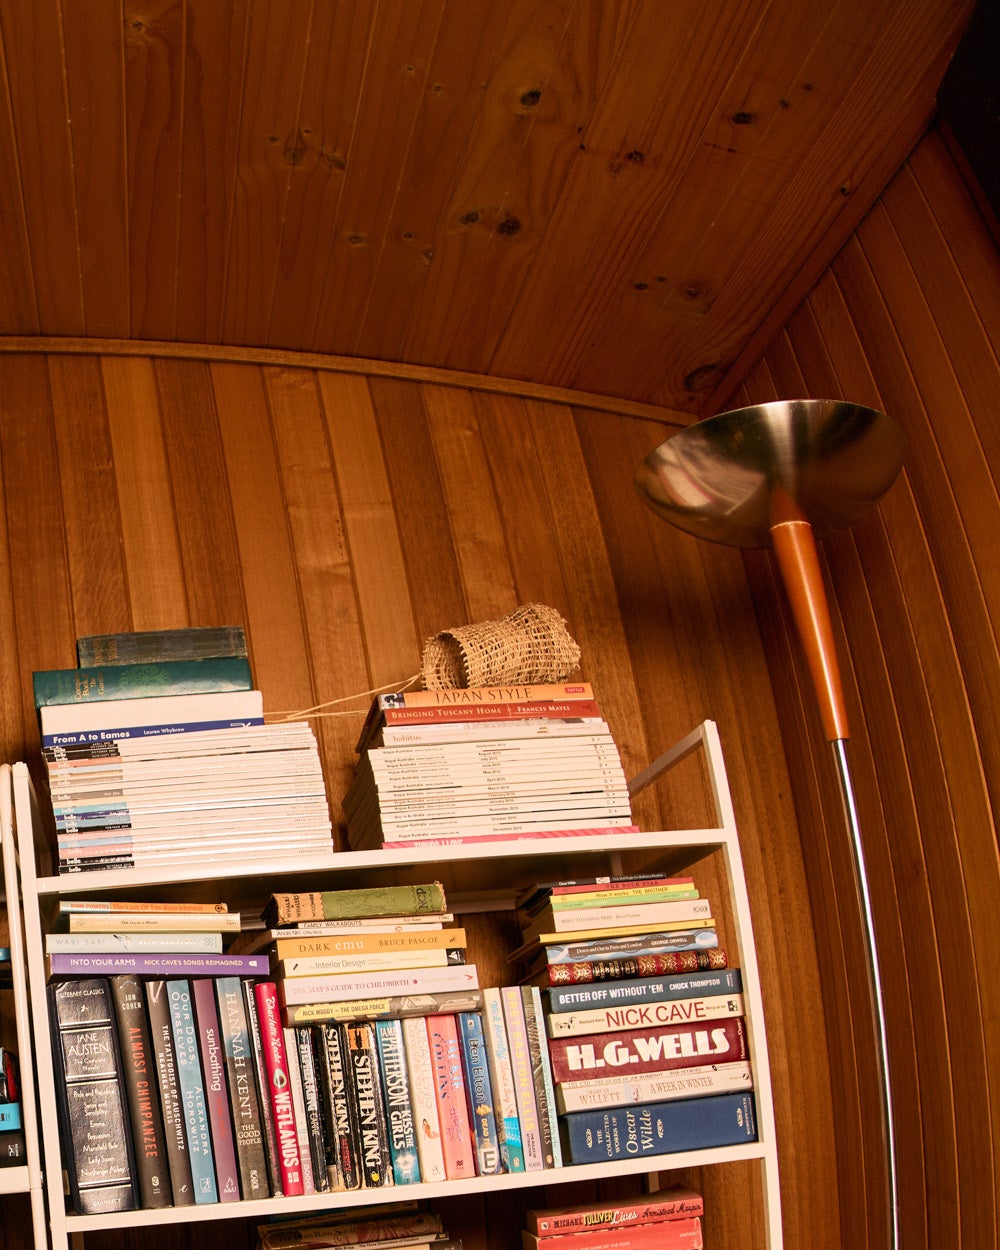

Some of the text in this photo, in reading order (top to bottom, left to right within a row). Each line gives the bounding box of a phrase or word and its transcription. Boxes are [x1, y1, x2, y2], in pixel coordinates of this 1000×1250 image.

[436, 688, 532, 704] JAPAN STYLE
[391, 709, 434, 719] BRINGING
[436, 709, 474, 717] TUSCANY
[52, 730, 130, 743] From A to Eames
[299, 940, 364, 952] DARK emu
[408, 937, 438, 945] PASCOE
[690, 979, 720, 988] THOMPSON
[559, 992, 590, 1004] BETTER
[592, 991, 608, 1000] OFF
[610, 986, 646, 998] WITHOUT
[605, 1002, 706, 1028] NICK CAVE
[76, 1033, 98, 1043] JANE
[68, 1042, 110, 1056] AUSTEN
[225, 992, 252, 1118] HANNAH KENT
[206, 1028, 220, 1091] sunbathing
[274, 1092, 298, 1167] WETLANDS
[626, 1111, 638, 1154] Oscar
[642, 1109, 651, 1151] Wilde
